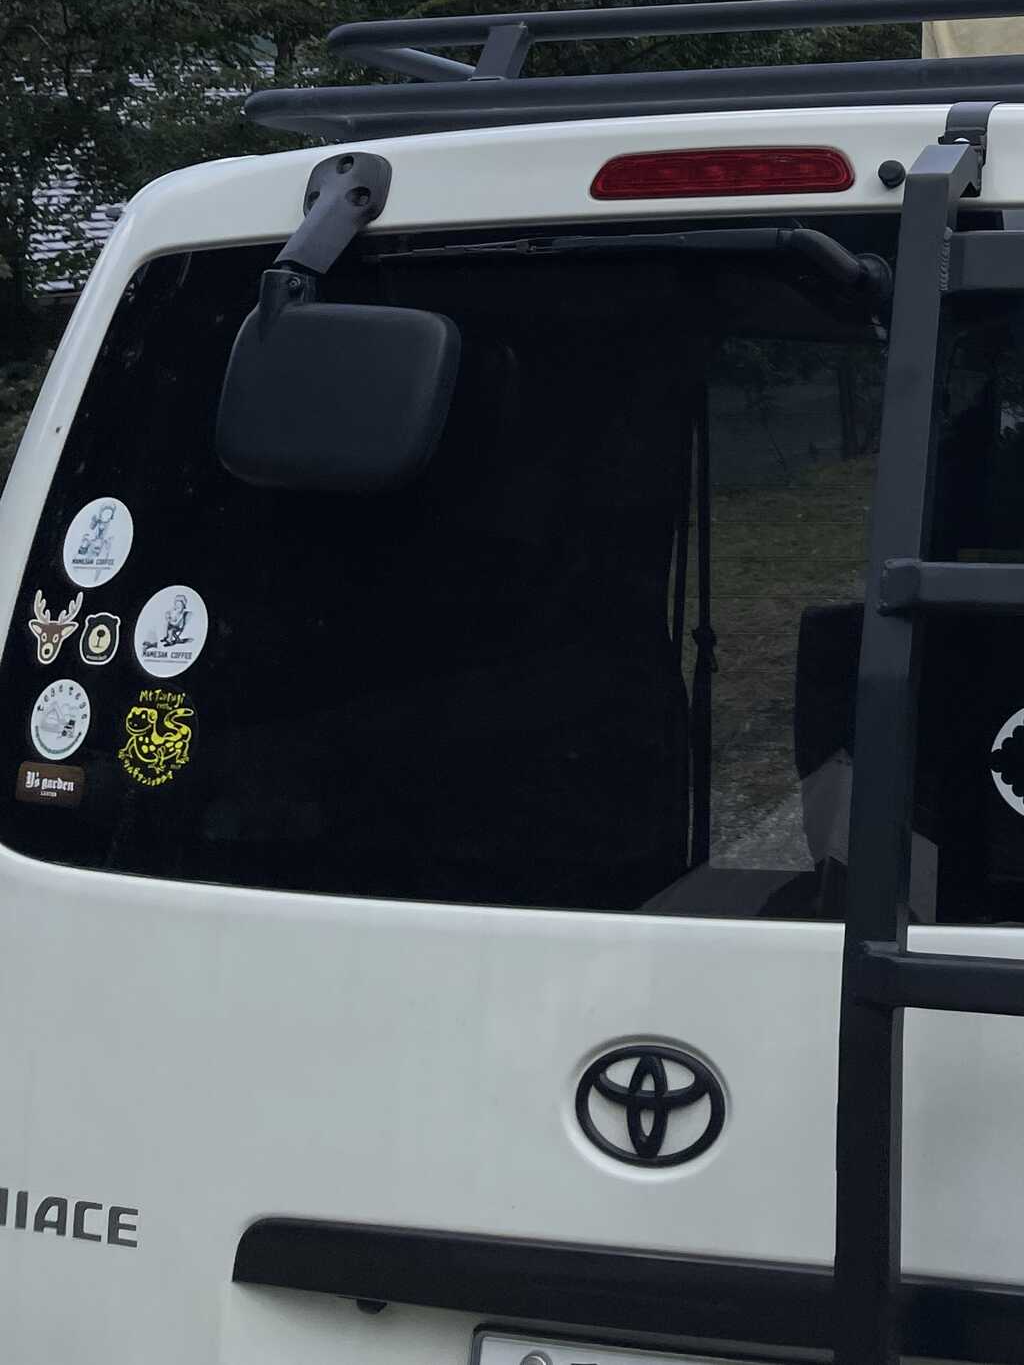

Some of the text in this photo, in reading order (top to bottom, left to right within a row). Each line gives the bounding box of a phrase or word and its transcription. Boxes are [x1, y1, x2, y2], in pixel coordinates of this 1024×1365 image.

[170, 651, 193, 660] COFFEE
[41, 777, 75, 792] garden
[0, 1187, 139, 1248] IACE
